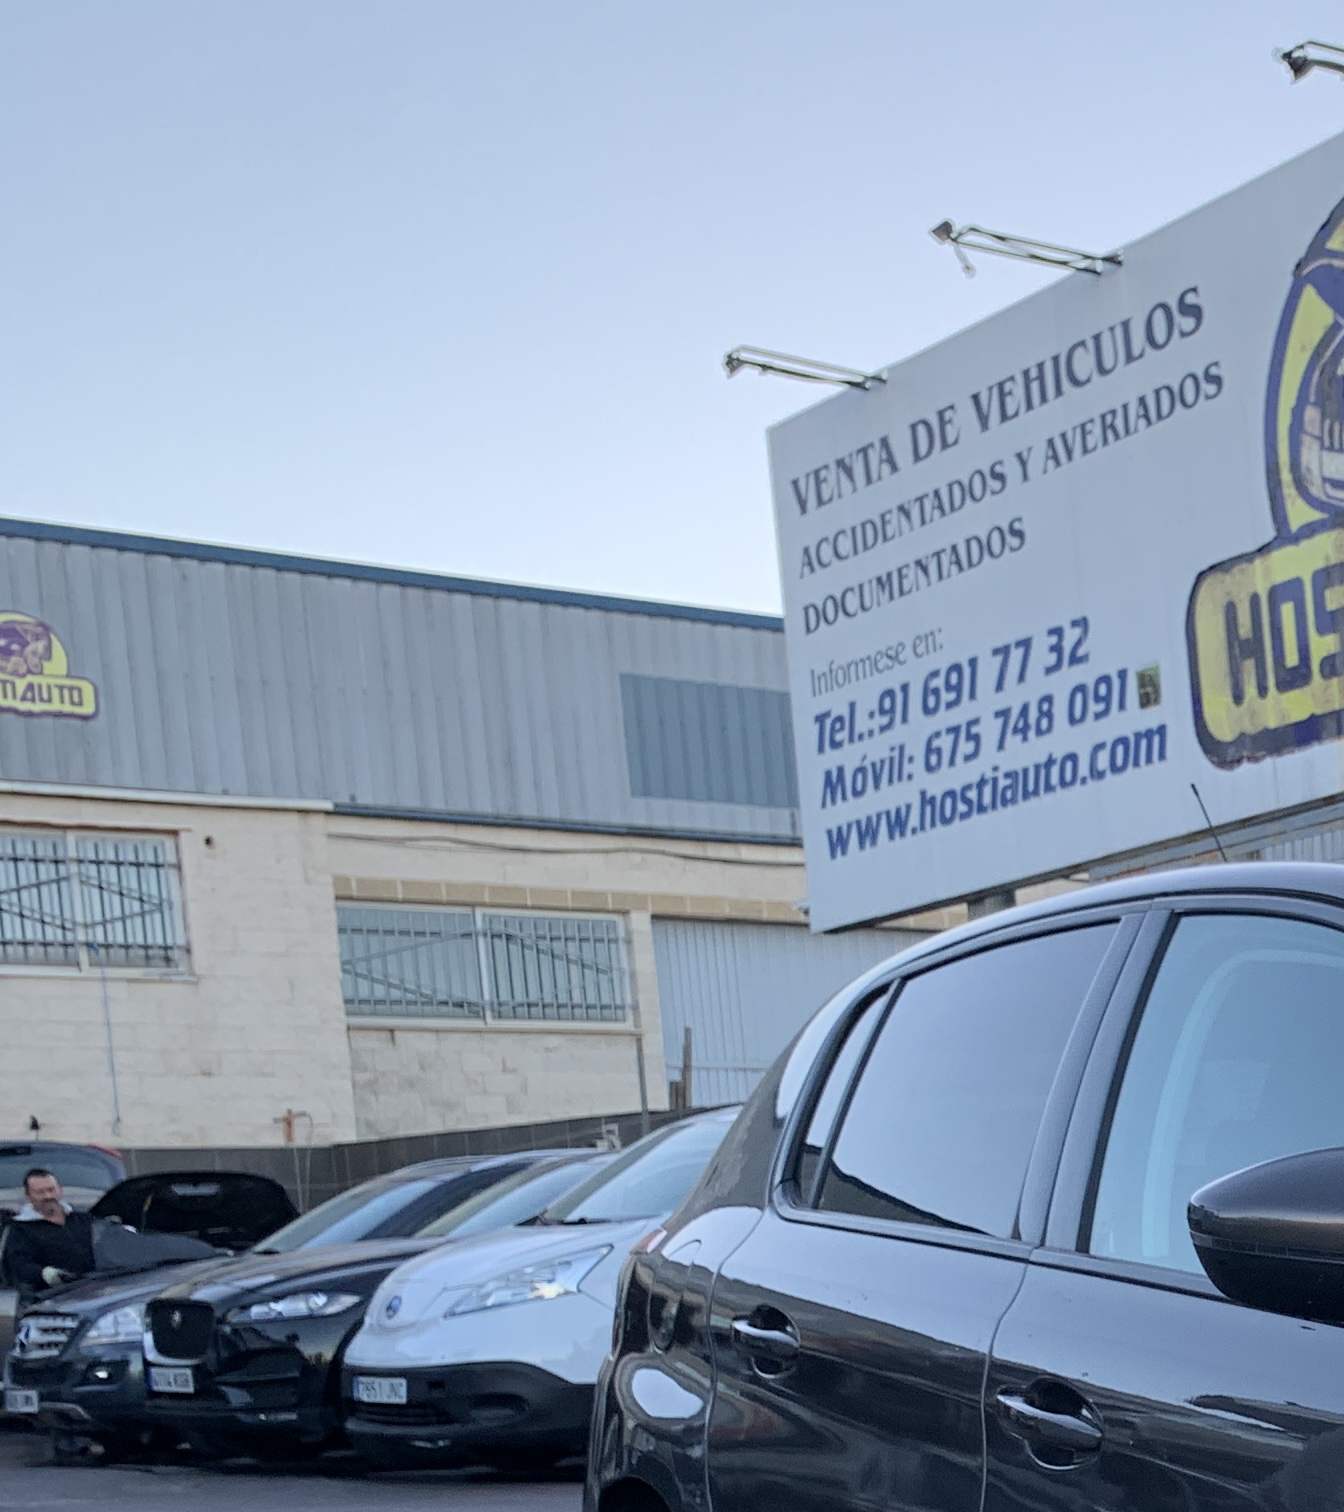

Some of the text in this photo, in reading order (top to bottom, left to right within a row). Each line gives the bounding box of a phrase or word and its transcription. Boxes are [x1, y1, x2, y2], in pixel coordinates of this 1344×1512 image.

[790, 286, 1204, 516] VENTA DE VEHICULOS
[799, 361, 1223, 580] ACCIDENTADOS Y AVERIADOS
[802, 516, 1026, 636] DOCUMENTADOS
[810, 627, 944, 698] Informese en:
[921, 656, 979, 717] 691
[991, 636, 1034, 694] 77
[1043, 615, 1090, 677] 32
[820, 667, 1128, 809] Móvil: 675 748 091
[826, 723, 1168, 861] www.hostiauto.com
